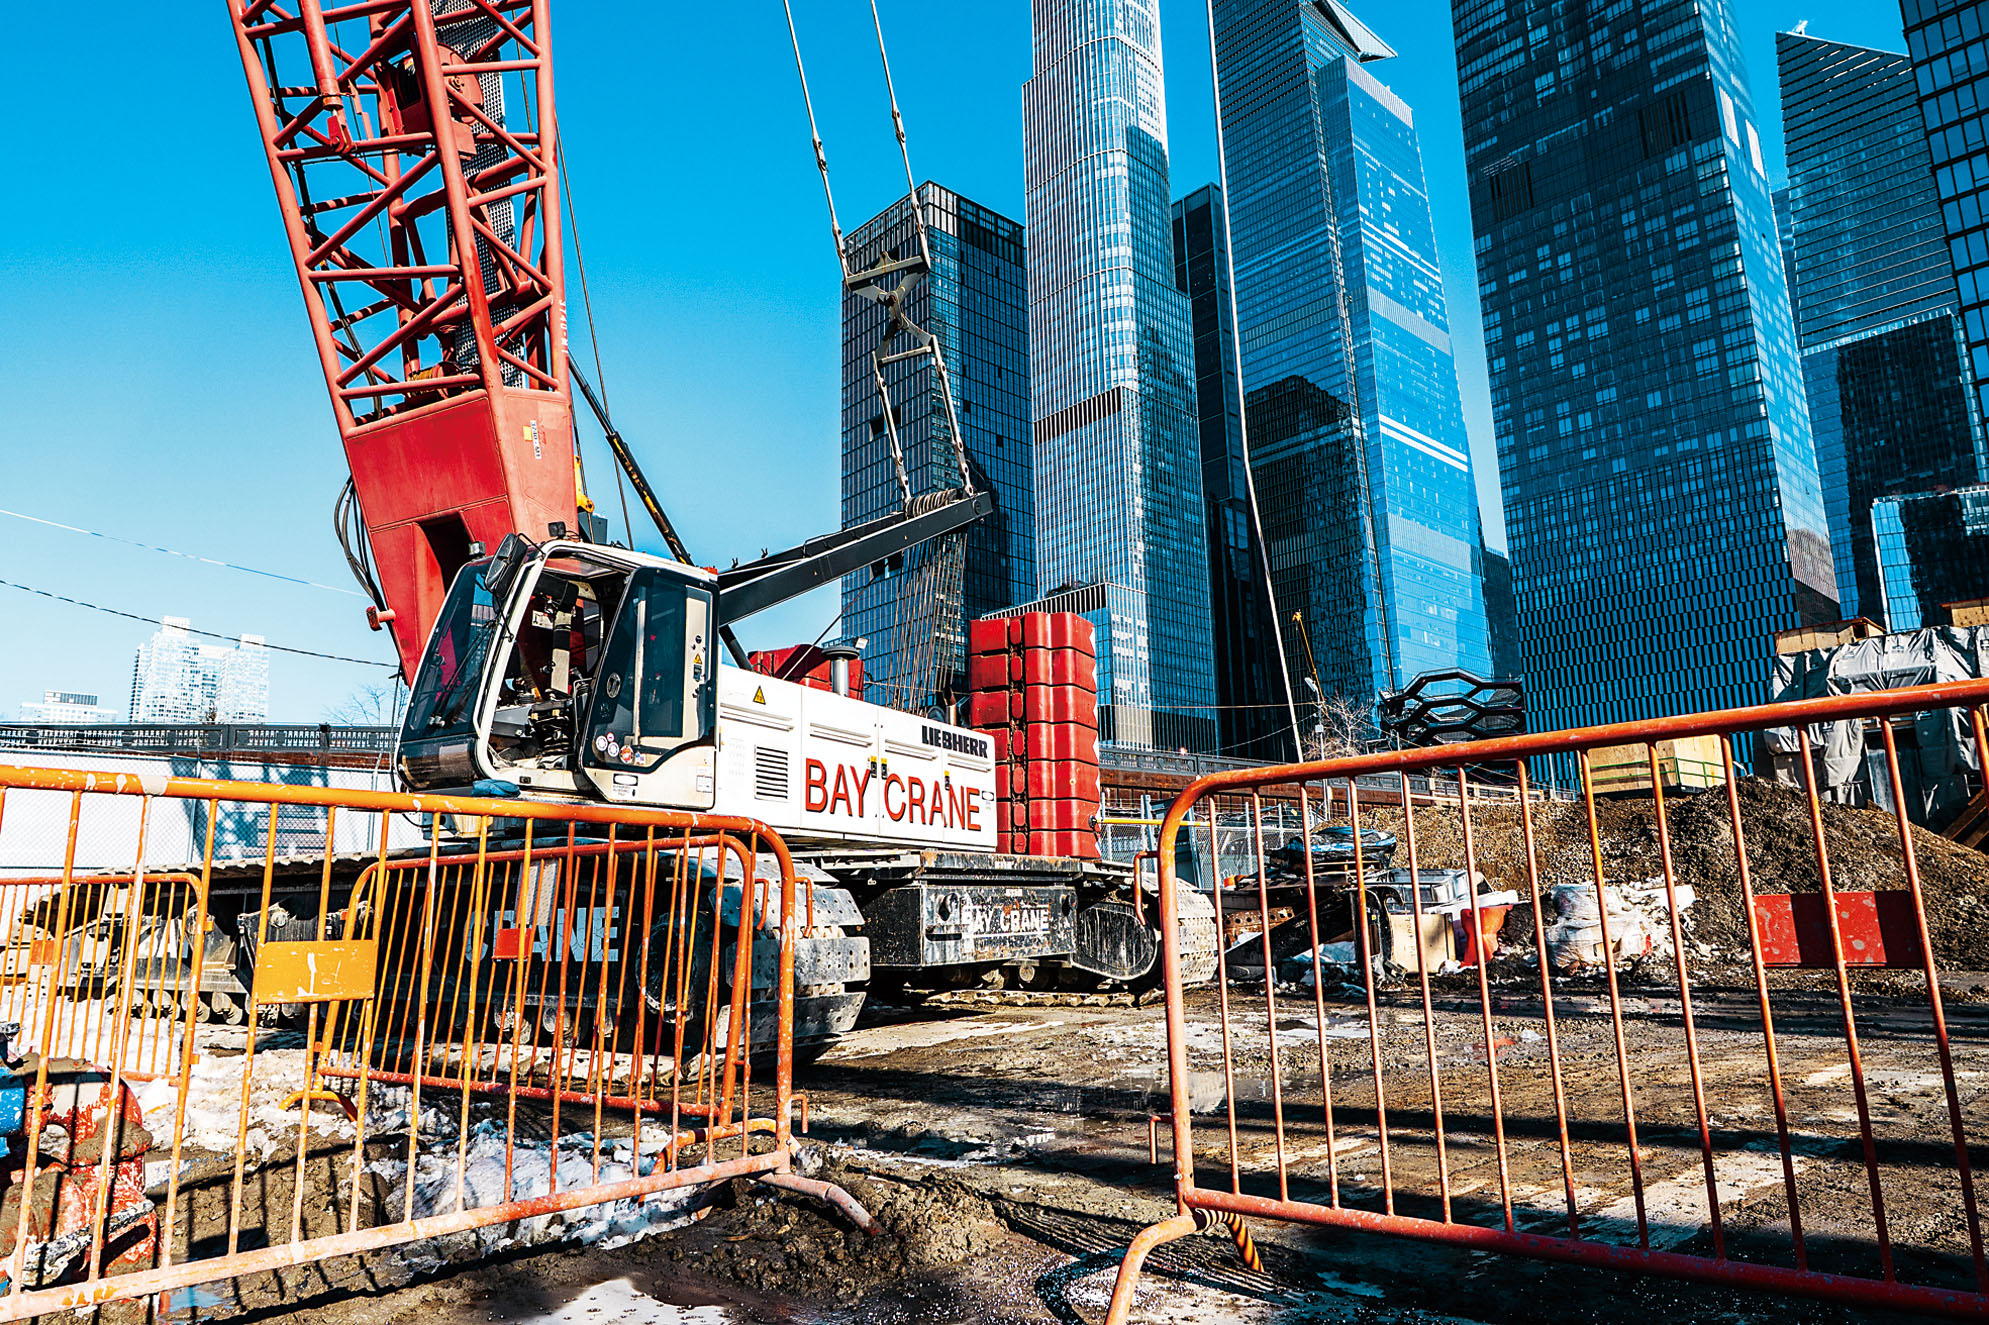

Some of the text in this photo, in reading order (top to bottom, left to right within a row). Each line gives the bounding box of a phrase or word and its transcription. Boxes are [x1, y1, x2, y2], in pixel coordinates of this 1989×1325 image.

[921, 724, 988, 759] LIEBHERR
[805, 757, 982, 831] BAY CRANE
[1000, 908, 1049, 932] CRANE
